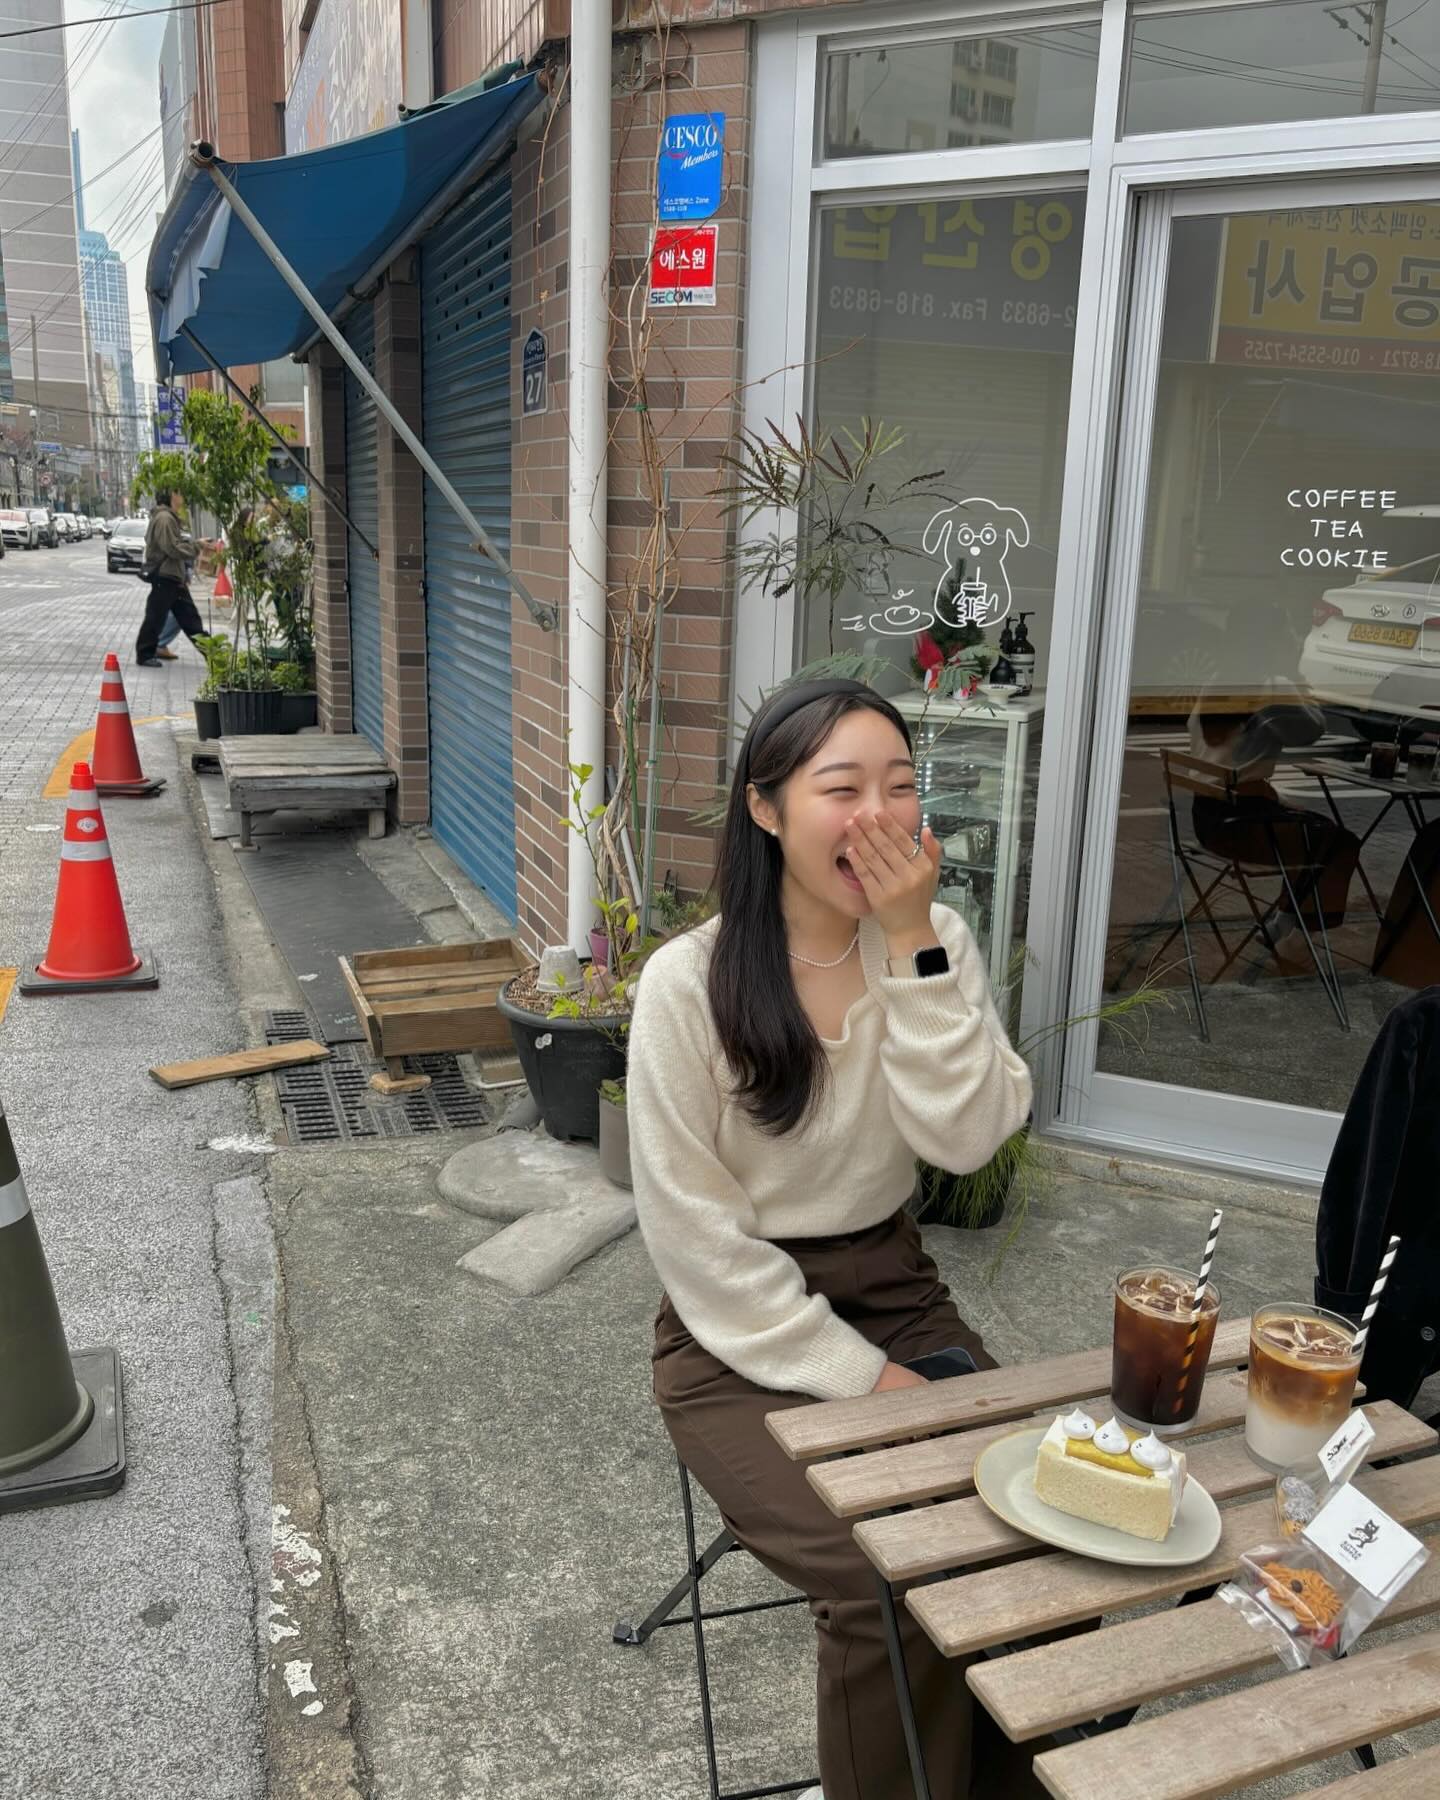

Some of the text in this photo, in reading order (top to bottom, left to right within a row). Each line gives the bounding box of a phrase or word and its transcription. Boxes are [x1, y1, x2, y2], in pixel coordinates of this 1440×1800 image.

[665, 124, 718, 149] CESCO
[659, 248, 706, 271] 에스원
[651, 290, 693, 304] SECOM
[526, 371, 543, 405] 27
[1287, 489, 1397, 509] COFFEE
[1310, 519, 1363, 538] TEA
[1280, 548, 1388, 569] COOKIE
